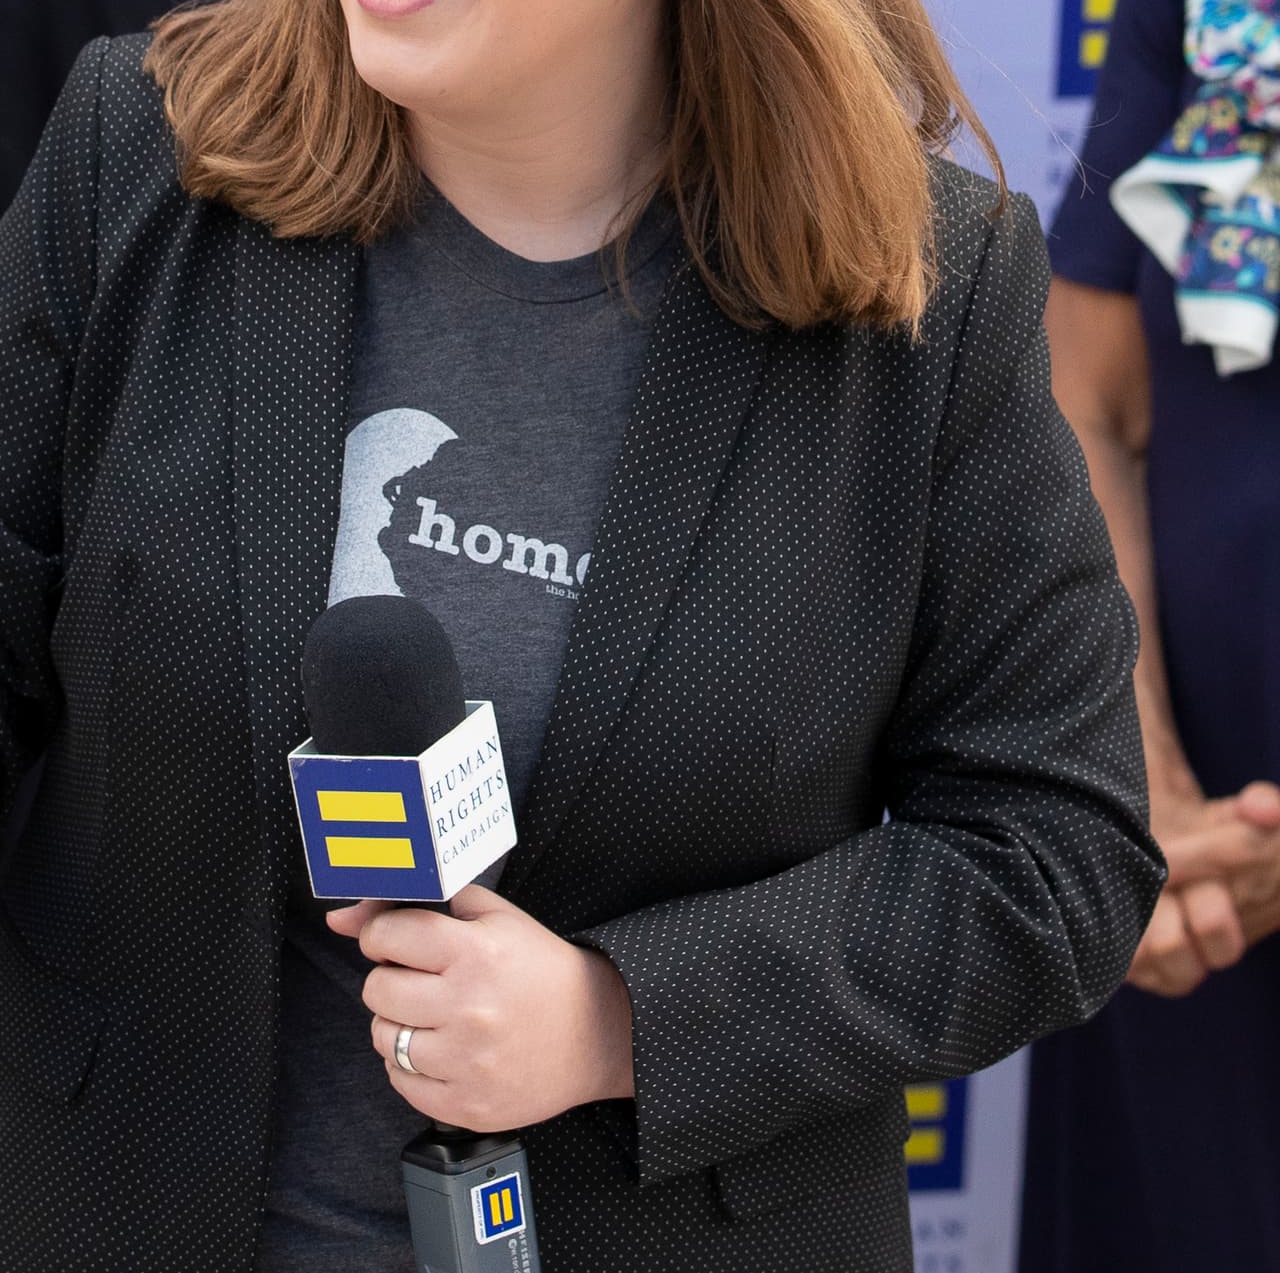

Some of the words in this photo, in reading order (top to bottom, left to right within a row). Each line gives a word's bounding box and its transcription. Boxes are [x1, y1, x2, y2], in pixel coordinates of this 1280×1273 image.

[429, 735, 498, 805] HUMAN
[436, 768, 505, 838] RIGHTS
[442, 801, 510, 865] CAMPAIGN
